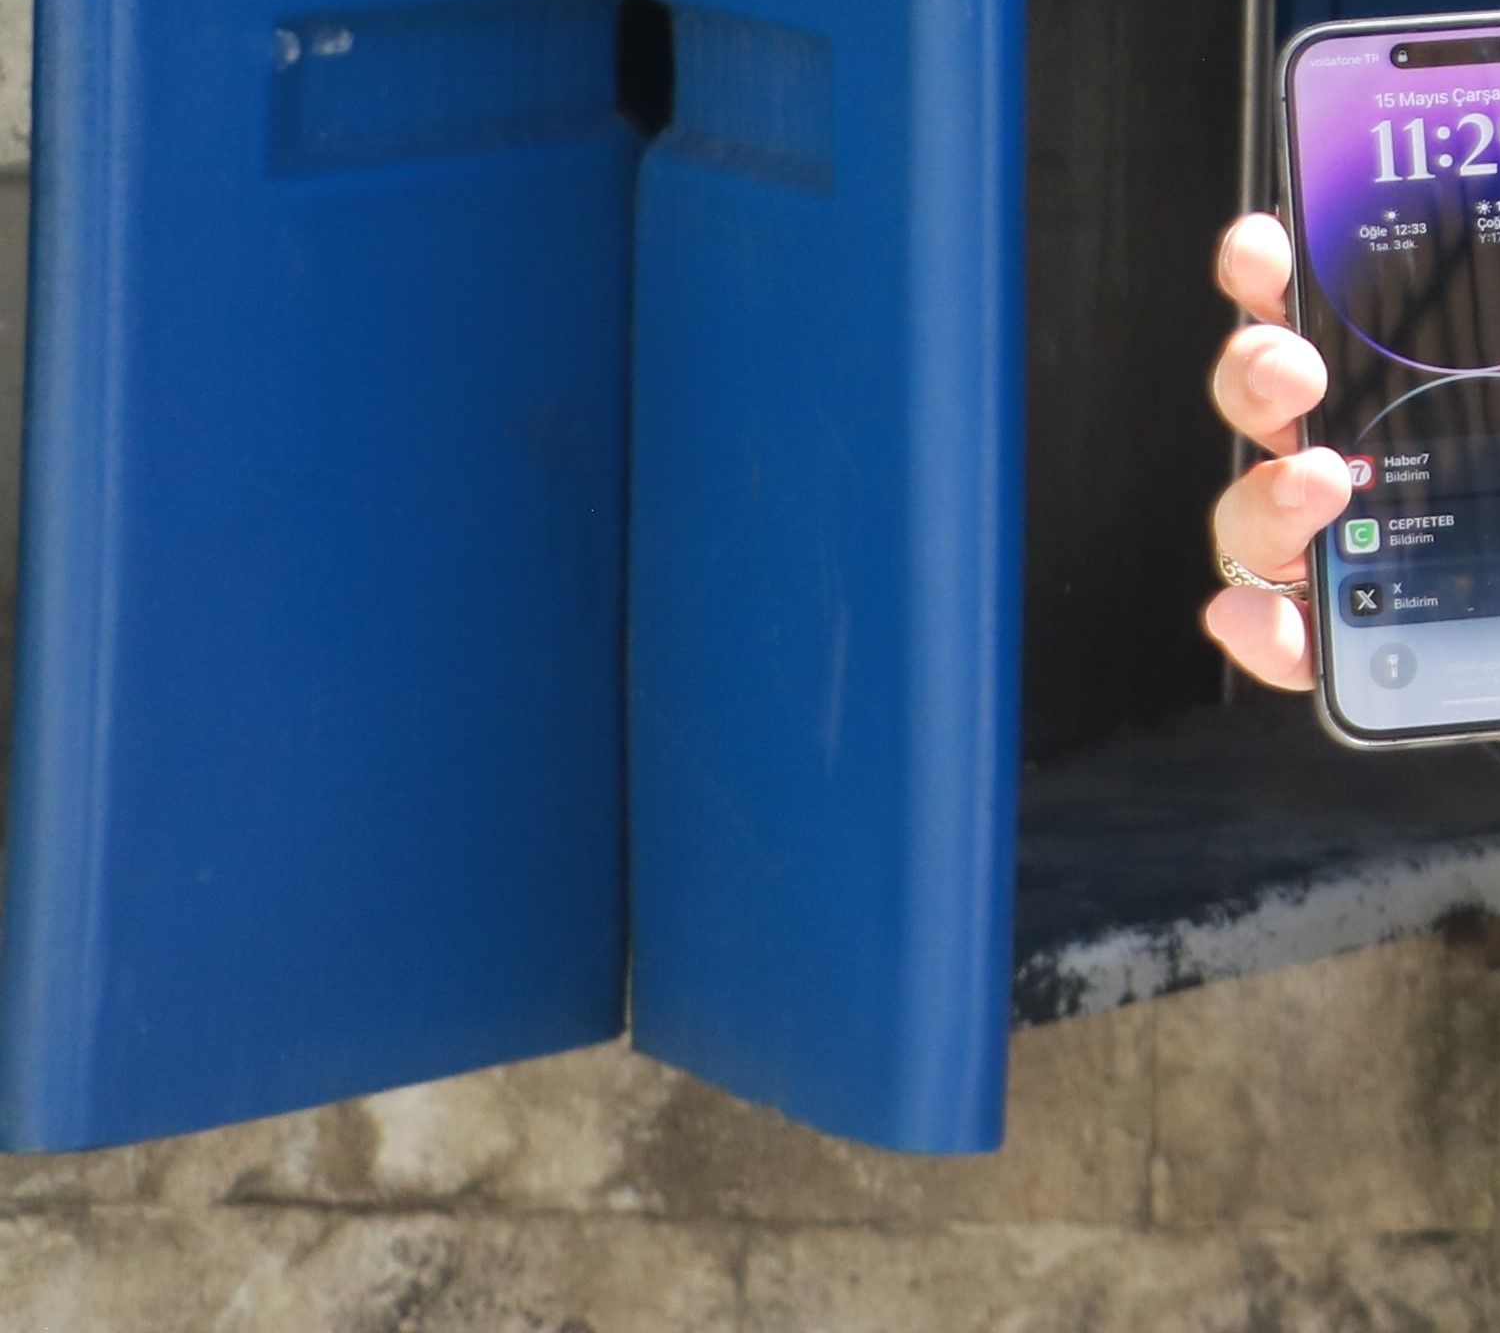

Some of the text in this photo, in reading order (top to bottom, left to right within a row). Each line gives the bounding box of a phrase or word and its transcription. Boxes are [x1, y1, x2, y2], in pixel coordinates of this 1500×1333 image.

[1310, 53, 1380, 68] vodafone TR
[1375, 92, 1395, 109] 15
[1399, 91, 1448, 109] Mayıs
[1359, 222, 1427, 239] Öğle 12:33
[1384, 453, 1430, 467] Haber7
[1385, 470, 1430, 483] Bildirim
[1388, 514, 1455, 531] CEPTETEB
[1389, 533, 1435, 547] Bildirim
[1394, 596, 1439, 610] Bildirim
